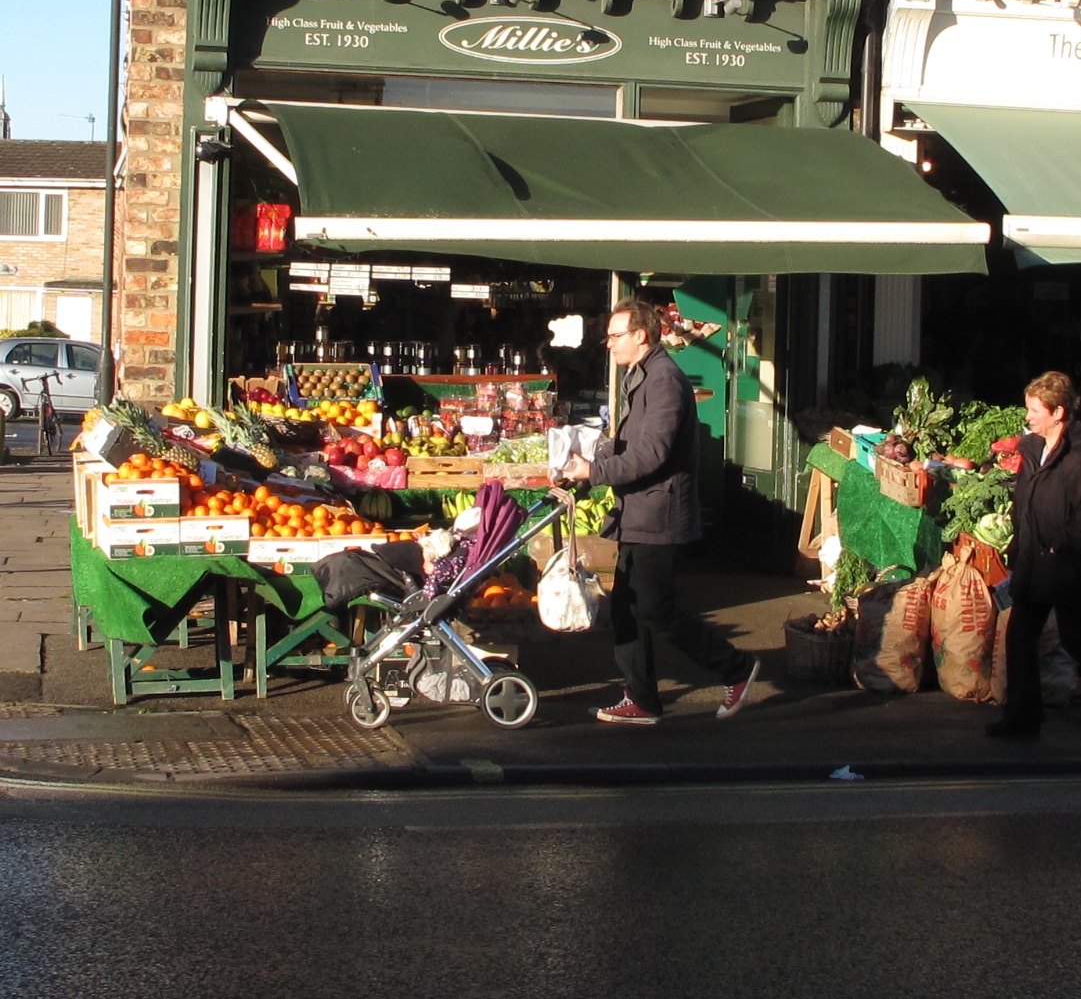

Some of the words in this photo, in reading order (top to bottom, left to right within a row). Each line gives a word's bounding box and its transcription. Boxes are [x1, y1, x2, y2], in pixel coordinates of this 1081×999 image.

[266, 17, 290, 30] High
[292, 18, 318, 28] Class
[320, 19, 344, 30] Fruit
[346, 20, 355, 31] &
[357, 21, 408, 34] Vegetables
[305, 33, 331, 46] EST.
[338, 34, 369, 48] 1930
[461, 25, 600, 53] Millie's
[648, 36, 672, 49] High
[674, 38, 698, 48] Class
[700, 39, 722, 50] Fruit
[723, 40, 732, 50] &
[734, 41, 782, 54] Vegetables
[685, 52, 710, 65] EST.
[716, 53, 745, 67] 1930
